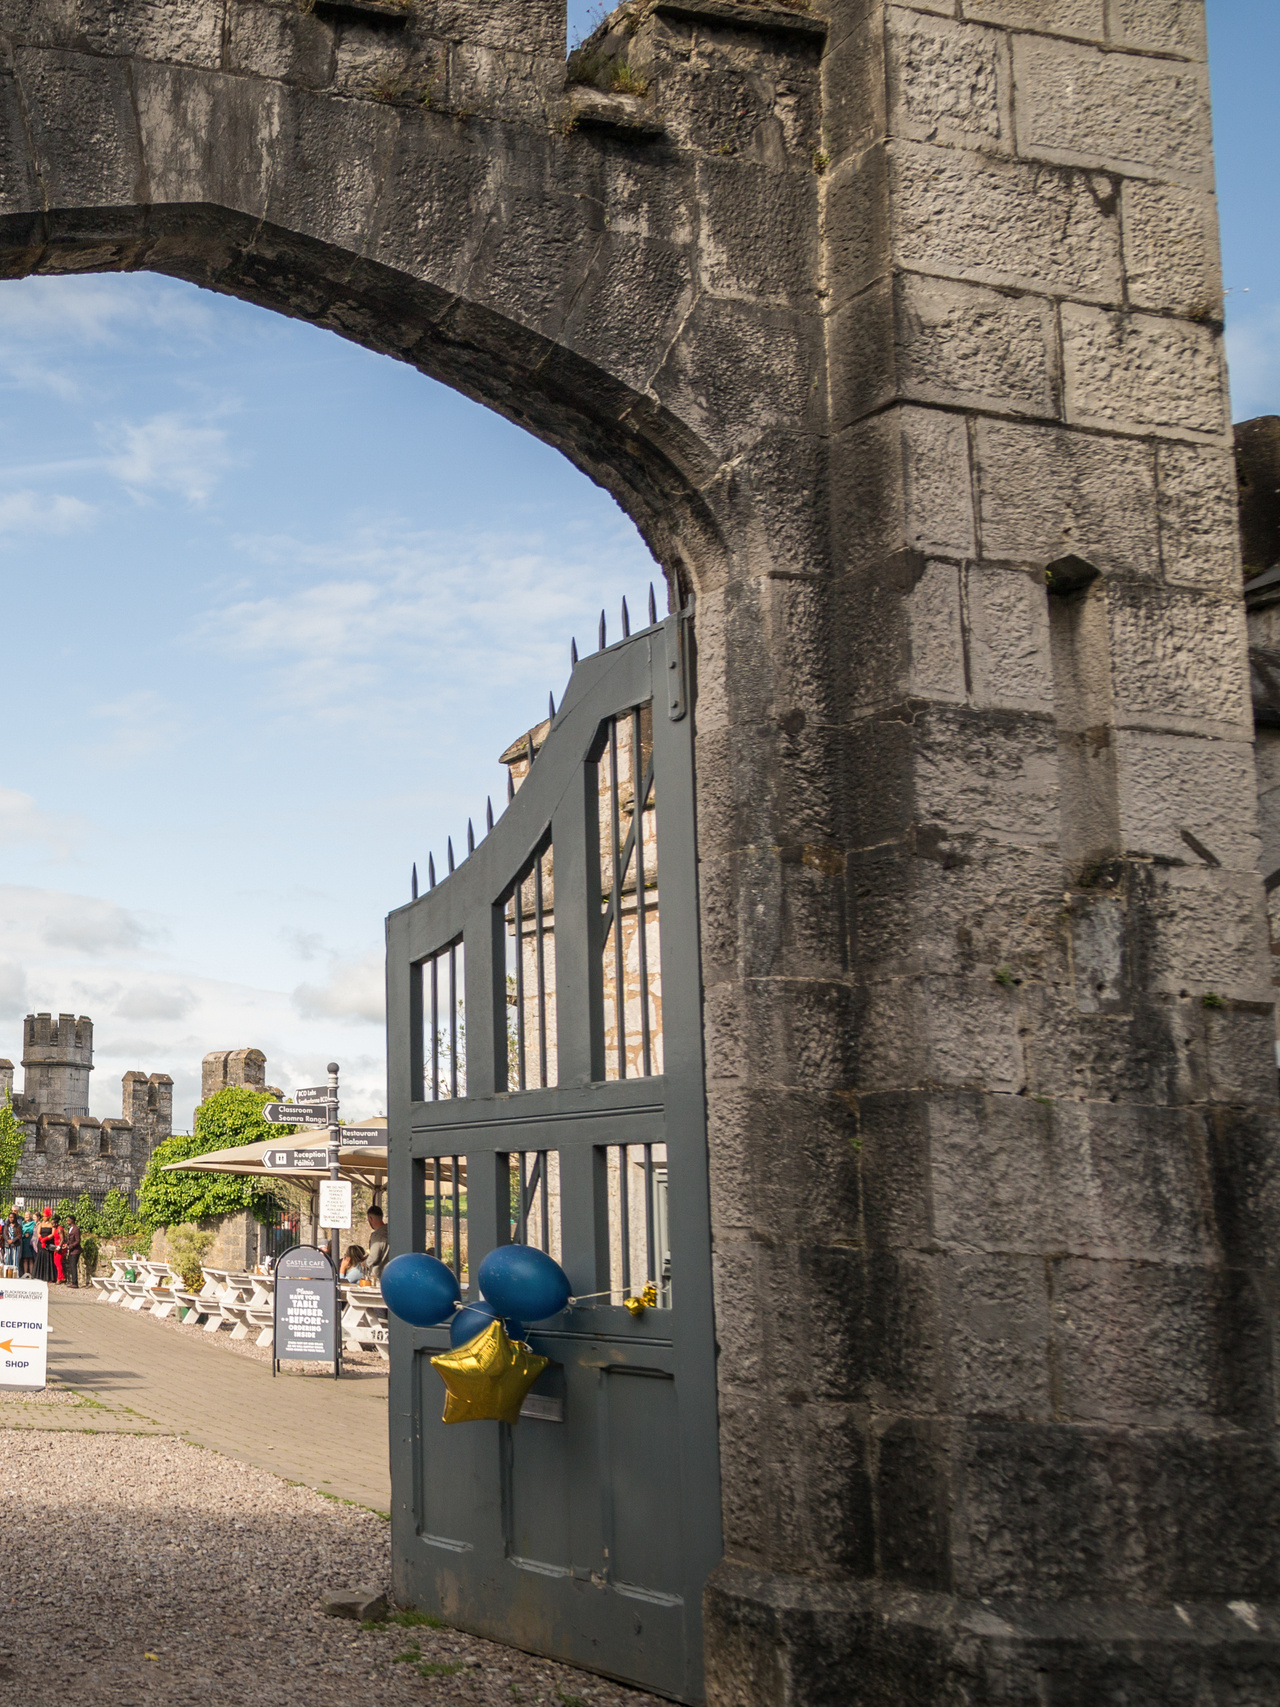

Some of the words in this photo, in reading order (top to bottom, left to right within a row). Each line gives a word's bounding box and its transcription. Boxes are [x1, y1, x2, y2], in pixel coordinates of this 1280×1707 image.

[279, 1105, 313, 1114] Classroom
[306, 1116, 326, 1124] Ranga
[342, 1129, 378, 1137] Restaurant
[294, 1150, 326, 1159] Reception
[292, 1300, 318, 1308] TABLE
[287, 1307, 323, 1317] NUMBER
[289, 1316, 322, 1325] BEFORE
[288, 1324, 322, 1332] ORDERING
[5, 1360, 29, 1368] SHOP
